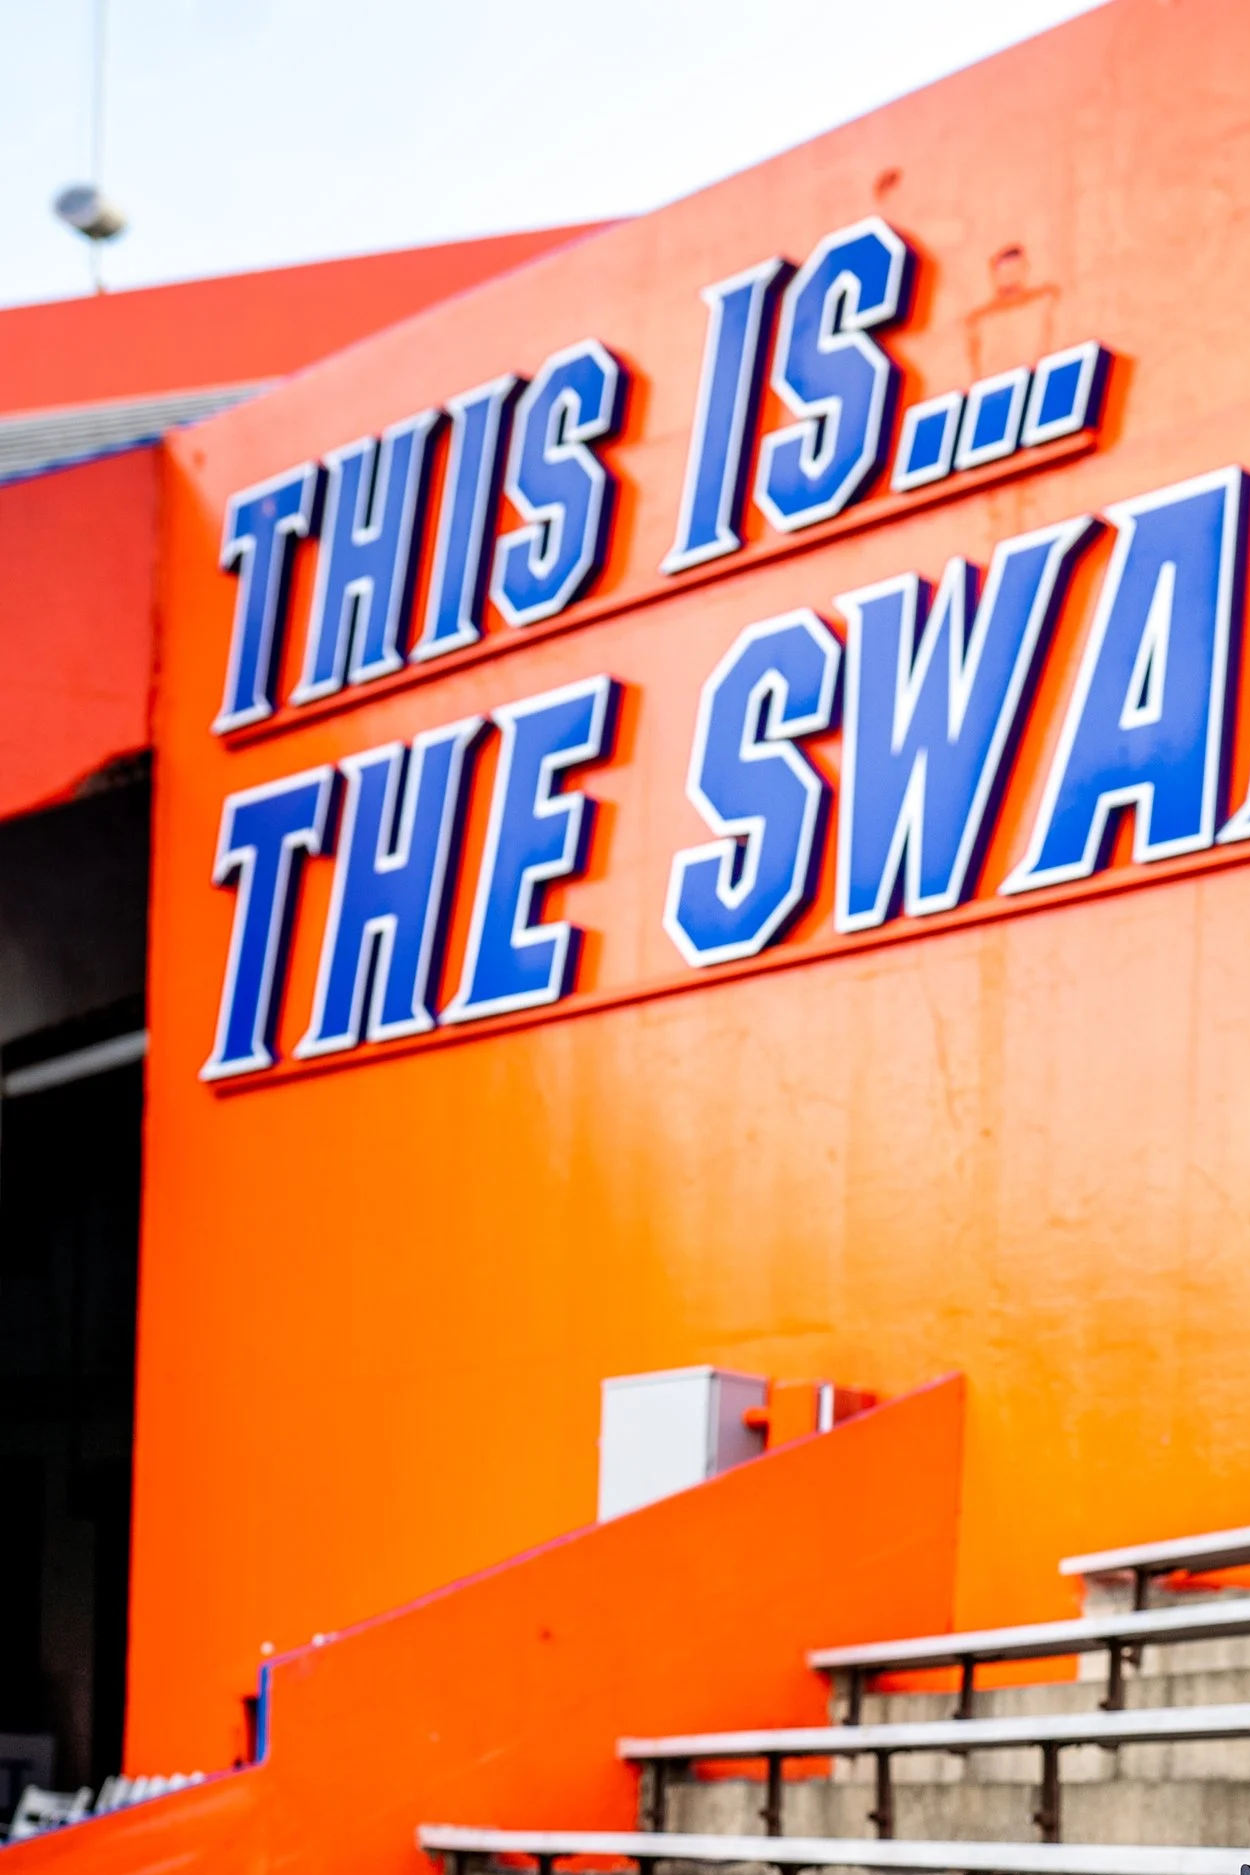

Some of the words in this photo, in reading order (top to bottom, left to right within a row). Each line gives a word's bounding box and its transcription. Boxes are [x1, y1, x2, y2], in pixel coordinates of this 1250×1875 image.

[212, 338, 624, 736] THIS
[659, 215, 1112, 577] IS...
[200, 673, 617, 1083] THE
